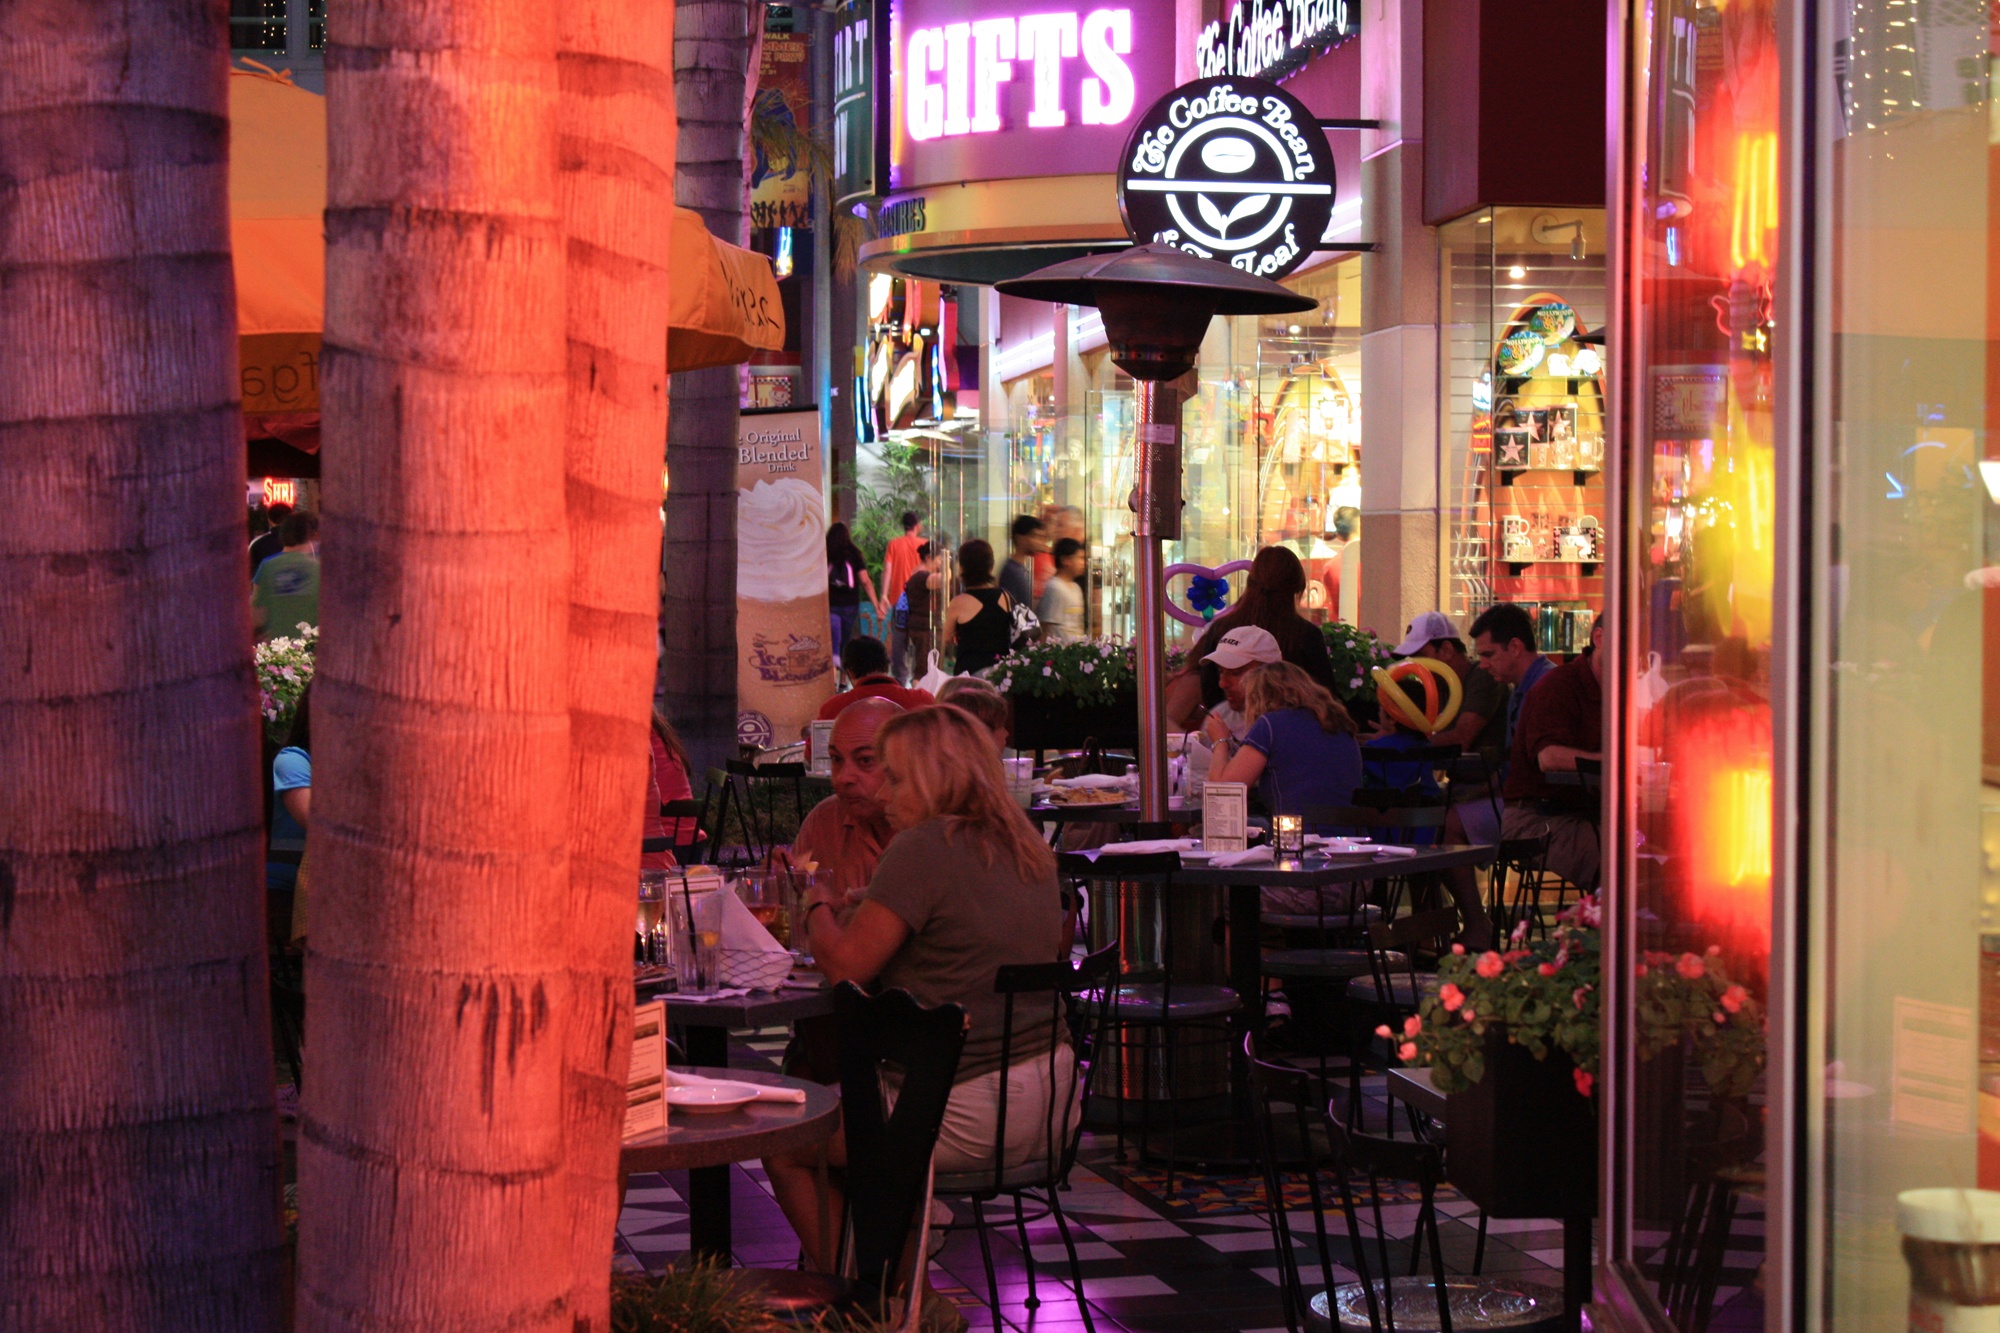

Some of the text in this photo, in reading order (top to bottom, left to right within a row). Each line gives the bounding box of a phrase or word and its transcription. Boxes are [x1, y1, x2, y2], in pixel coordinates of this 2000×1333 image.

[906, 8, 1135, 142] GIFTS
[1132, 84, 1315, 180] The Coffee Bean
[1231, 223, 1300, 276] Leaf
[739, 443, 810, 464] Blended
[746, 428, 802, 448] Original
[768, 463, 797, 473] Drink
